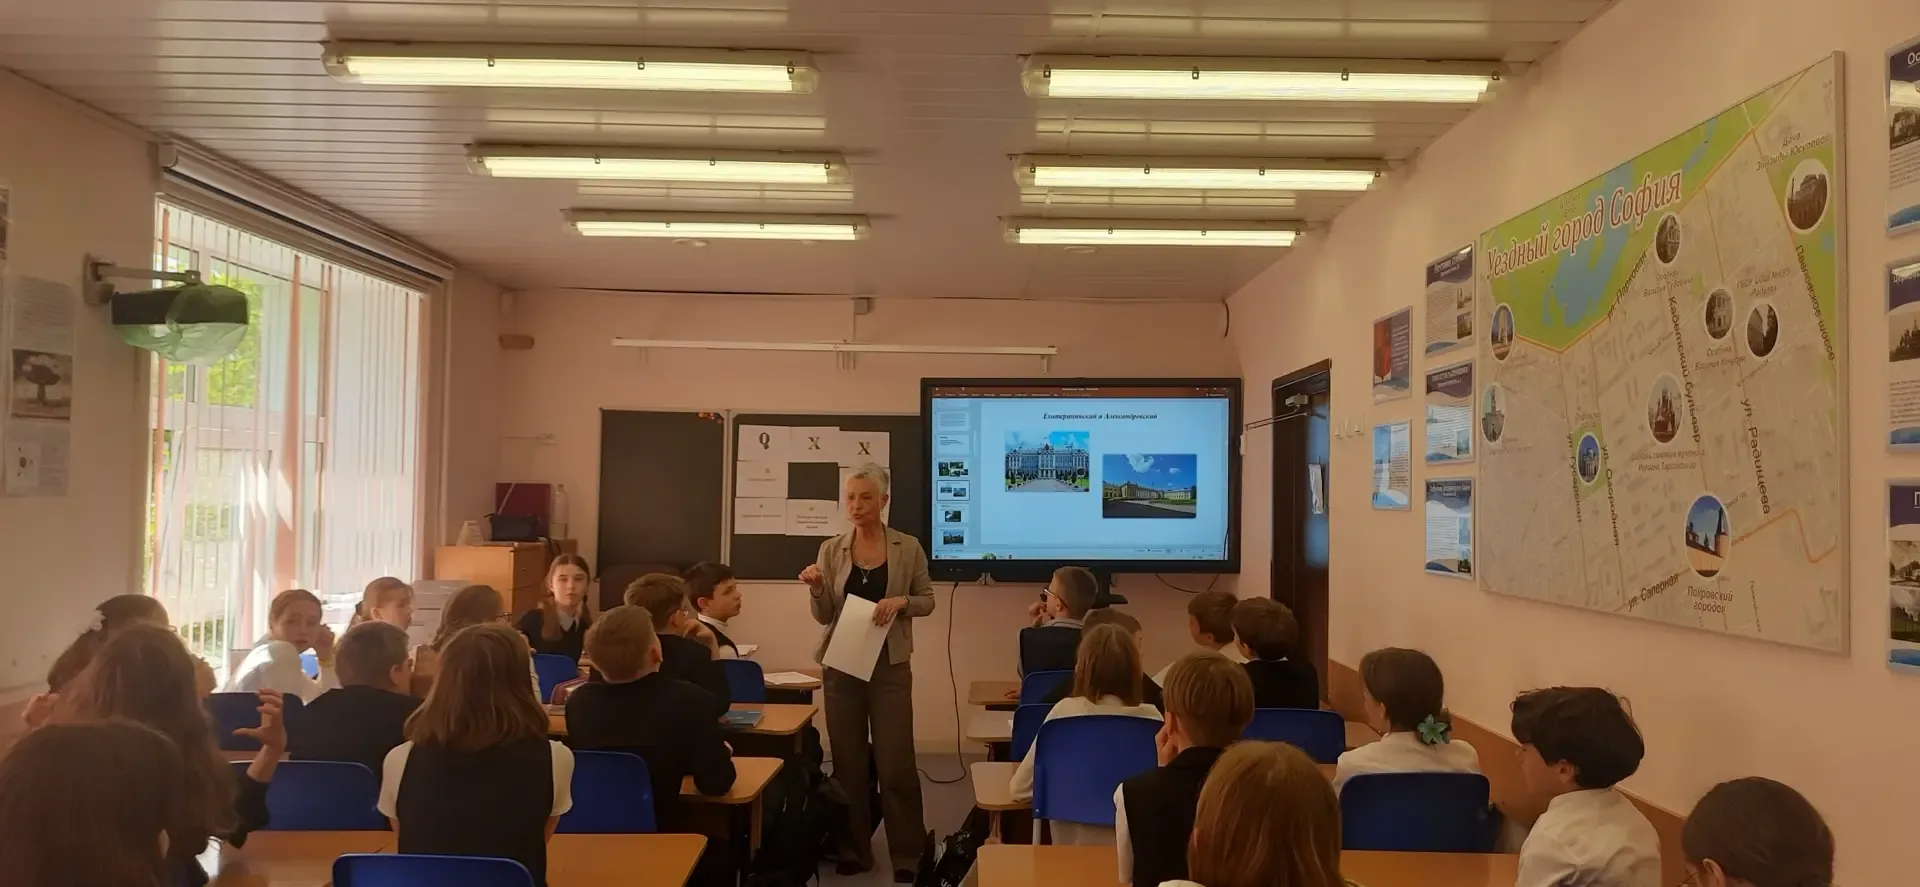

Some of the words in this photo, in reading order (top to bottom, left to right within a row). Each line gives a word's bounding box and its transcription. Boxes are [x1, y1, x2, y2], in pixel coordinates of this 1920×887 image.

[1486, 222, 1548, 279] Уездный
[1552, 197, 1604, 255] город
[1610, 171, 1681, 227] София
[1616, 251, 1648, 303] Парковая
[1795, 244, 1821, 318] Павловское
[1818, 319, 1836, 361] шоссе
[1668, 296, 1690, 378] Кадетский
[1684, 381, 1701, 443] бульвар
[1741, 398, 1753, 422] ул.
[1748, 426, 1771, 515] Радищева
[1606, 468, 1620, 546] Огородная
[1627, 596, 1639, 612] ул.
[1640, 572, 1680, 602] Саперная
[1687, 585, 1733, 602] Покровский
[1693, 600, 1726, 614] городок
